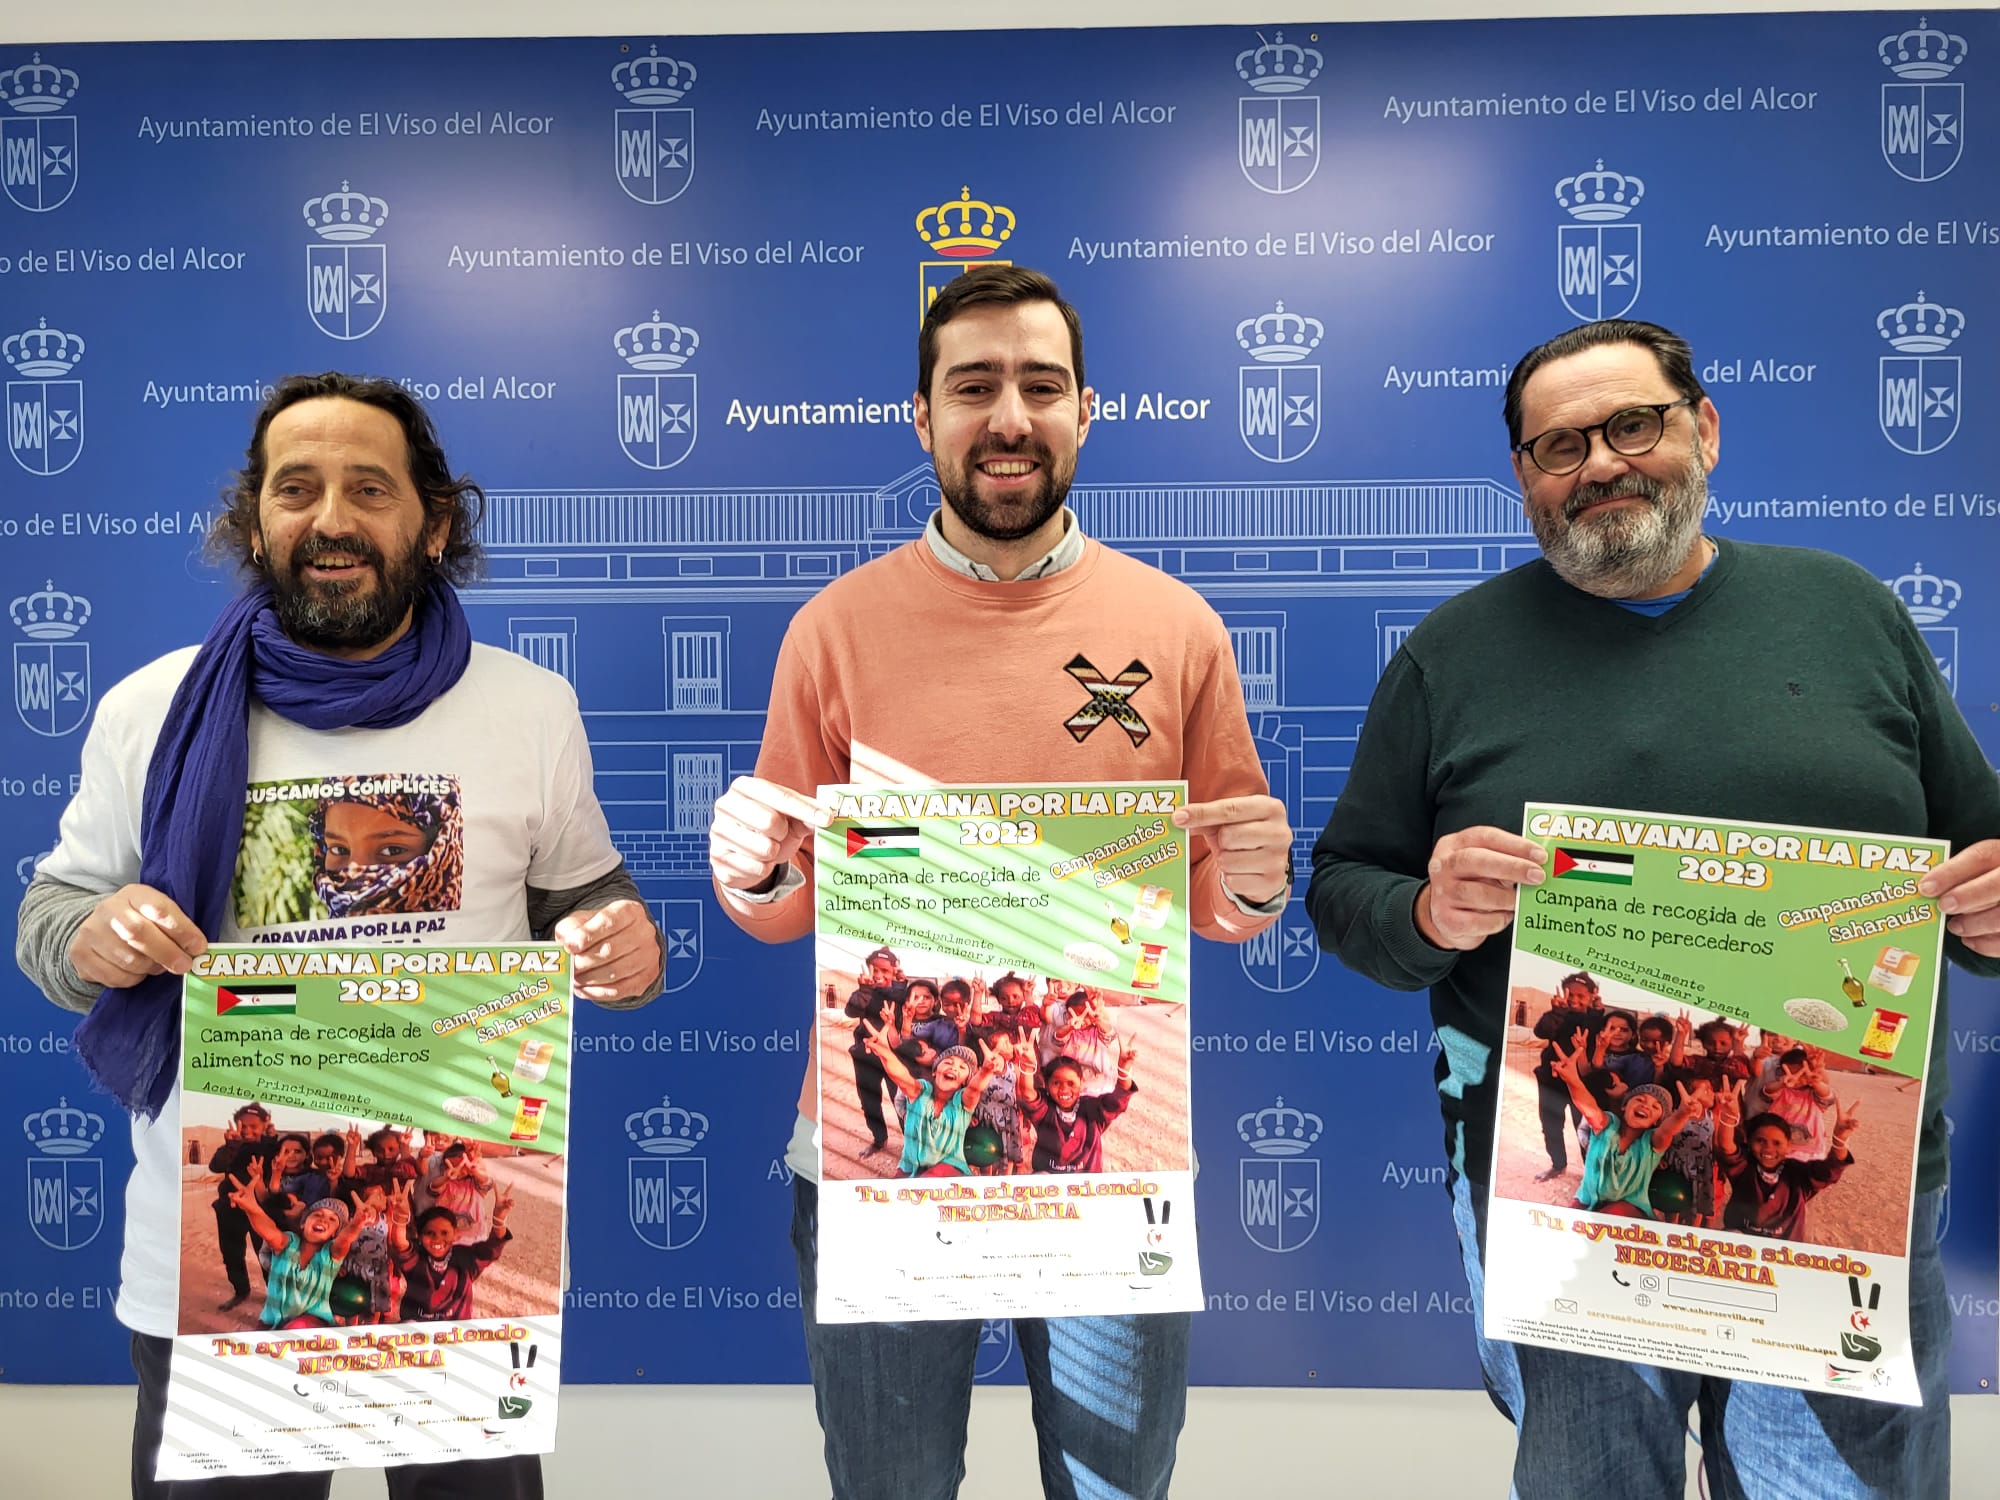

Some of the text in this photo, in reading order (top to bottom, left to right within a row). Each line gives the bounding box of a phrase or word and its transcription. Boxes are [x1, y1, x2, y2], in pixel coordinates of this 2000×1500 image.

[755, 100, 1177, 137] Ayuntamiento de El Viso del Alcor
[1383, 86, 1818, 125] Ayuntamiento de El Viso del Alcor
[137, 111, 554, 144] Ayuntamiento de El Viso del Alcor
[1068, 228, 1496, 266] Ayuntamiento de El Viso del Alcor
[1704, 220, 1957, 253] Ayuntamiento de El
[18, 249, 49, 273] de
[55, 248, 75, 273] El
[80, 249, 131, 272] Viso
[138, 247, 175, 271] del
[182, 246, 246, 270] Alcor
[447, 239, 865, 273] Ayuntamiento de El Viso del Alcor
[1702, 358, 1817, 384] del Alcor
[447, 375, 557, 401] del Alcor
[725, 392, 1211, 433] Ayuntamient del Alcor
[1704, 492, 1954, 525] Ayuntamiento de El
[25, 512, 55, 536] de
[62, 512, 81, 535] El
[86, 512, 137, 535] Viso
[144, 511, 181, 535] del
[32, 773, 62, 796] de
[245, 778, 451, 804] BUSCAMOS CÓMPLICES
[1000, 792, 1065, 816] POR
[1071, 791, 1110, 815] LA
[1115, 791, 1176, 815] PAZ
[960, 821, 1038, 845] 2023
[1528, 813, 1933, 872] CARAVANA POR LA PAZ
[1049, 819, 1166, 880] Campamentos
[832, 865, 1041, 890] Campaña de recogida de
[1094, 842, 1179, 888] Saharauis
[1677, 855, 1769, 888] 2023
[825, 892, 1050, 914] alimentos no perecederos
[1534, 888, 1767, 931] Campaña de recogida de
[1777, 879, 1918, 929] Campamentos
[351, 921, 388, 939] POR
[391, 920, 413, 935] LA
[415, 917, 446, 934] PAZ
[1524, 912, 1775, 956] alimentos no perecederos
[1829, 904, 1932, 944] Saharauis
[191, 950, 562, 977] CARAVANA POR LA PAZ
[1586, 946, 1706, 993] Principalmente
[338, 979, 421, 1003] 2023
[1533, 943, 1585, 968] Aceite,
[1694, 996, 1707, 1007] y
[1707, 998, 1751, 1019] pasta
[431, 978, 551, 1035] Campamentos
[200, 1022, 422, 1046] Campaña de recogida de
[477, 999, 563, 1043] Saharauis
[39, 1031, 68, 1054] de
[642, 1029, 673, 1052] de
[680, 1029, 699, 1052] El
[705, 1030, 756, 1052] Viso
[763, 1029, 800, 1052] del
[1255, 1029, 1287, 1052] de
[1294, 1029, 1314, 1053] El
[1320, 1030, 1373, 1053] Viso
[1380, 1029, 1418, 1053] del
[191, 1048, 430, 1071] alimentos no perecederos
[256, 1077, 372, 1105] Principalmente
[855, 1178, 1158, 1205] Tu ayuda sigue siendo
[937, 1202, 1080, 1222] NECESARIA
[1528, 1209, 1868, 1277] Tu ayuda sigue siendo
[1615, 1243, 1775, 1286] NECESARIA
[49, 1286, 75, 1309] de
[82, 1286, 101, 1309] El
[646, 1285, 677, 1309] de
[684, 1285, 703, 1308] El
[708, 1286, 760, 1309] Viso
[766, 1286, 804, 1309] del
[1256, 1288, 1287, 1312] de
[1295, 1289, 1315, 1312] El
[1320, 1290, 1373, 1313] Viso
[1380, 1290, 1418, 1313] del
[212, 1324, 528, 1359] Tu ayuda sigue siendo
[297, 1349, 445, 1375] NECESARIA
